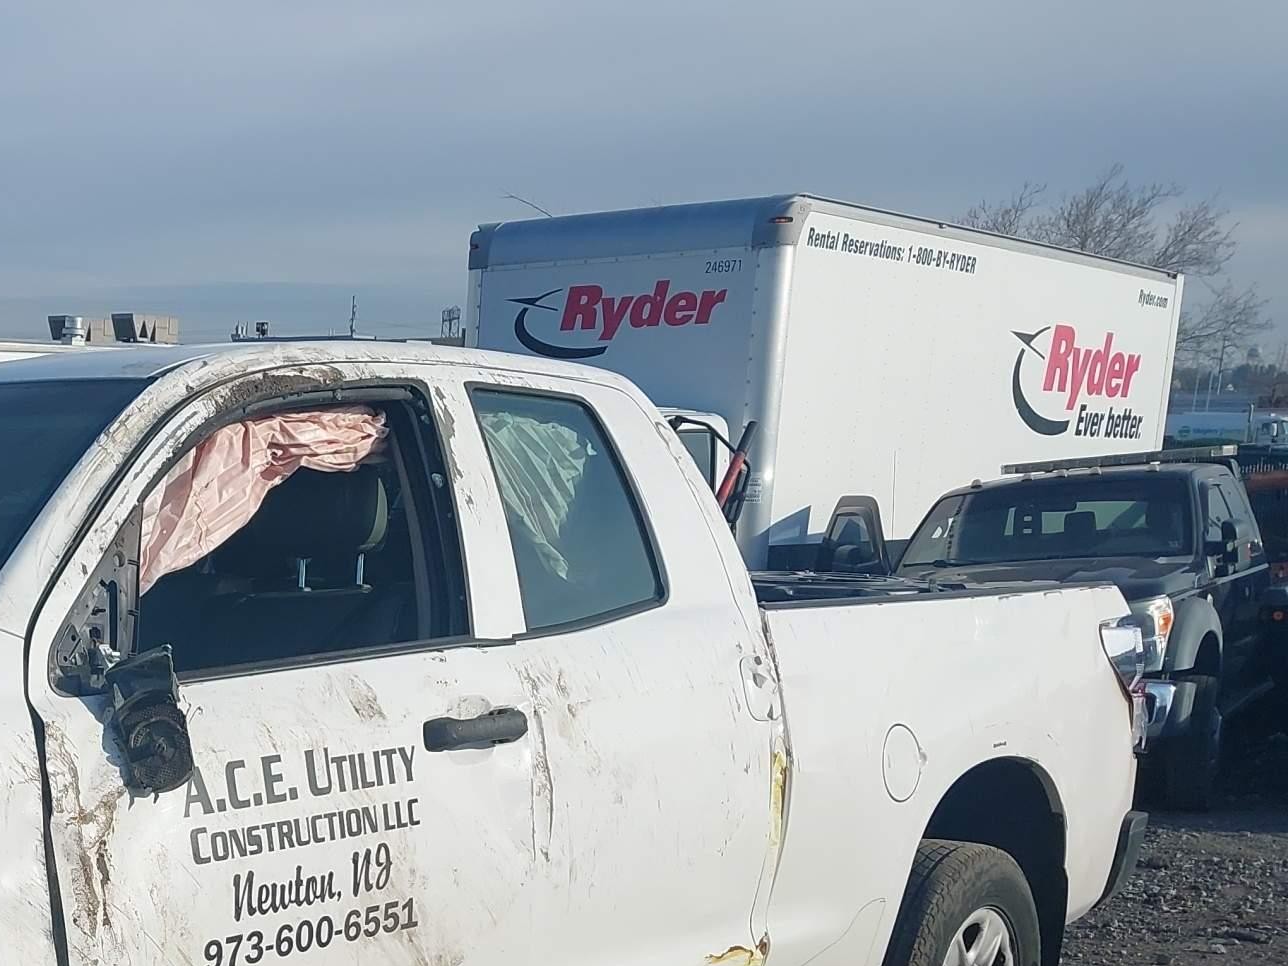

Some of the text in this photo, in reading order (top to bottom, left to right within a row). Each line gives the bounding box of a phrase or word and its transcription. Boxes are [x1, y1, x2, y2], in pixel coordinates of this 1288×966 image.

[705, 259, 743, 274] 246971
[807, 227, 977, 274] Rental Reservations: 1-800-BY-RYDER
[559, 279, 729, 341] Ryder
[1042, 323, 1142, 411] Ryder
[1074, 404, 1143, 440] Ever better.
[183, 754, 299, 818] A.C.E.
[382, 798, 421, 829] LLC
[233, 842, 393, 922] Newton, NJ
